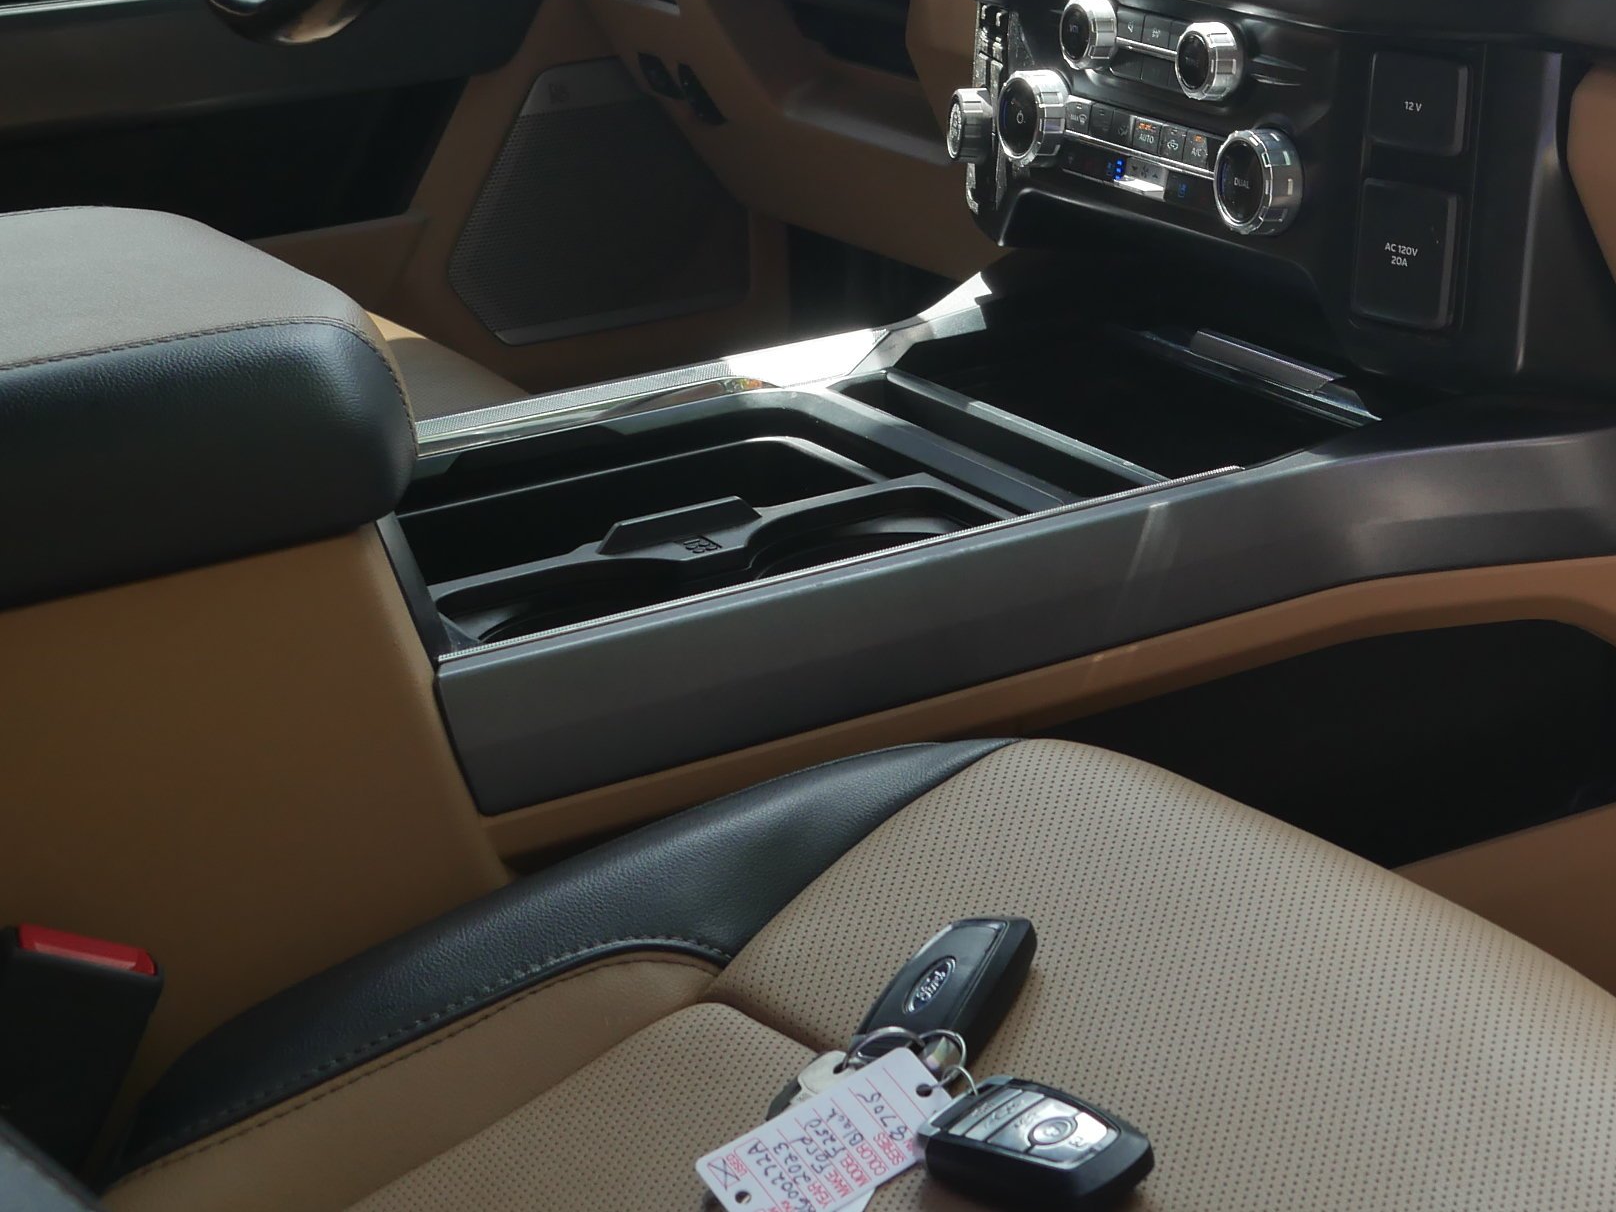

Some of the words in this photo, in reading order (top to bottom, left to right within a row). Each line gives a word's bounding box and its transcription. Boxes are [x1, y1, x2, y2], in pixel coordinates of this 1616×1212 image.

[1404, 101, 1414, 111] 12
[1414, 102, 1423, 113] V
[1138, 133, 1155, 145] AUTO
[1190, 146, 1202, 158] A/C
[1234, 177, 1250, 190] DUAL
[1384, 242, 1397, 253] AC
[1397, 244, 1418, 258] 120V
[1391, 255, 1408, 268] 20A
[824, 1108, 864, 1148] Black
[857, 1091, 907, 1142] 8705
[804, 1118, 846, 1160] F250
[873, 1132, 905, 1166] SERIES
[726, 1153, 748, 1177] USED
[773, 1141, 812, 1185] 2023
[788, 1135, 831, 1174] Ford
[856, 1143, 888, 1177] COLOR
[825, 1169, 853, 1198] MAKE
[840, 1154, 872, 1187] MODEL
[807, 1181, 831, 1209] YEAR
